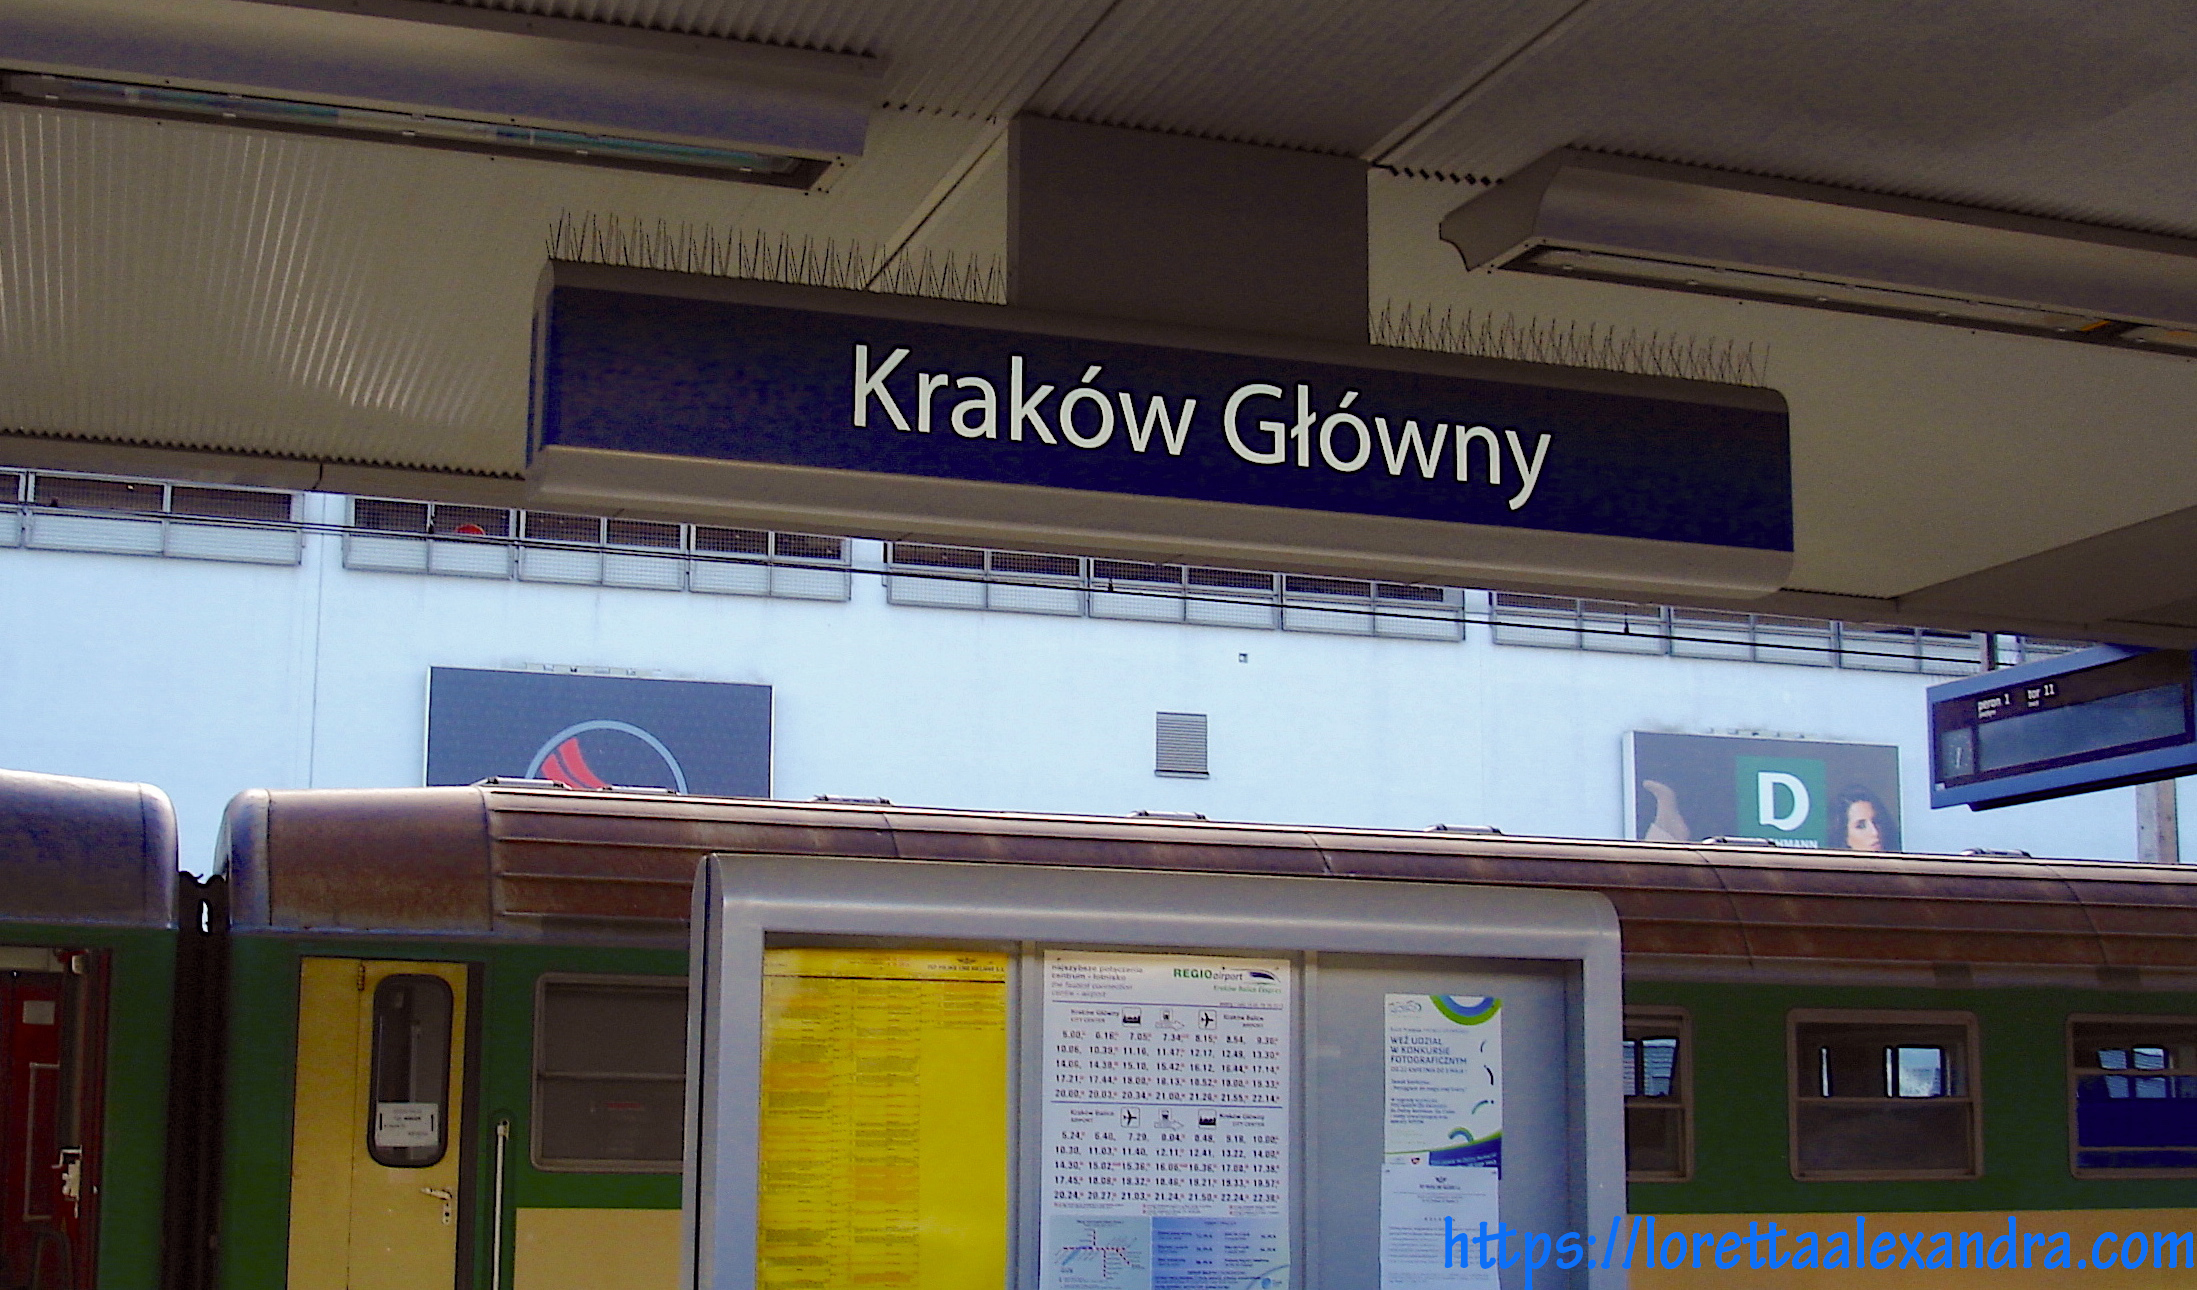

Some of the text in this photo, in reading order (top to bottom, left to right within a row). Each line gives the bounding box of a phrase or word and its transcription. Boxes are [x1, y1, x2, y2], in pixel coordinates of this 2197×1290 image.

[854, 344, 1552, 510] Kraków Główny
[2004, 693, 2010, 705] 1
[2044, 684, 2055, 696] 11
[1758, 772, 1809, 832] D
